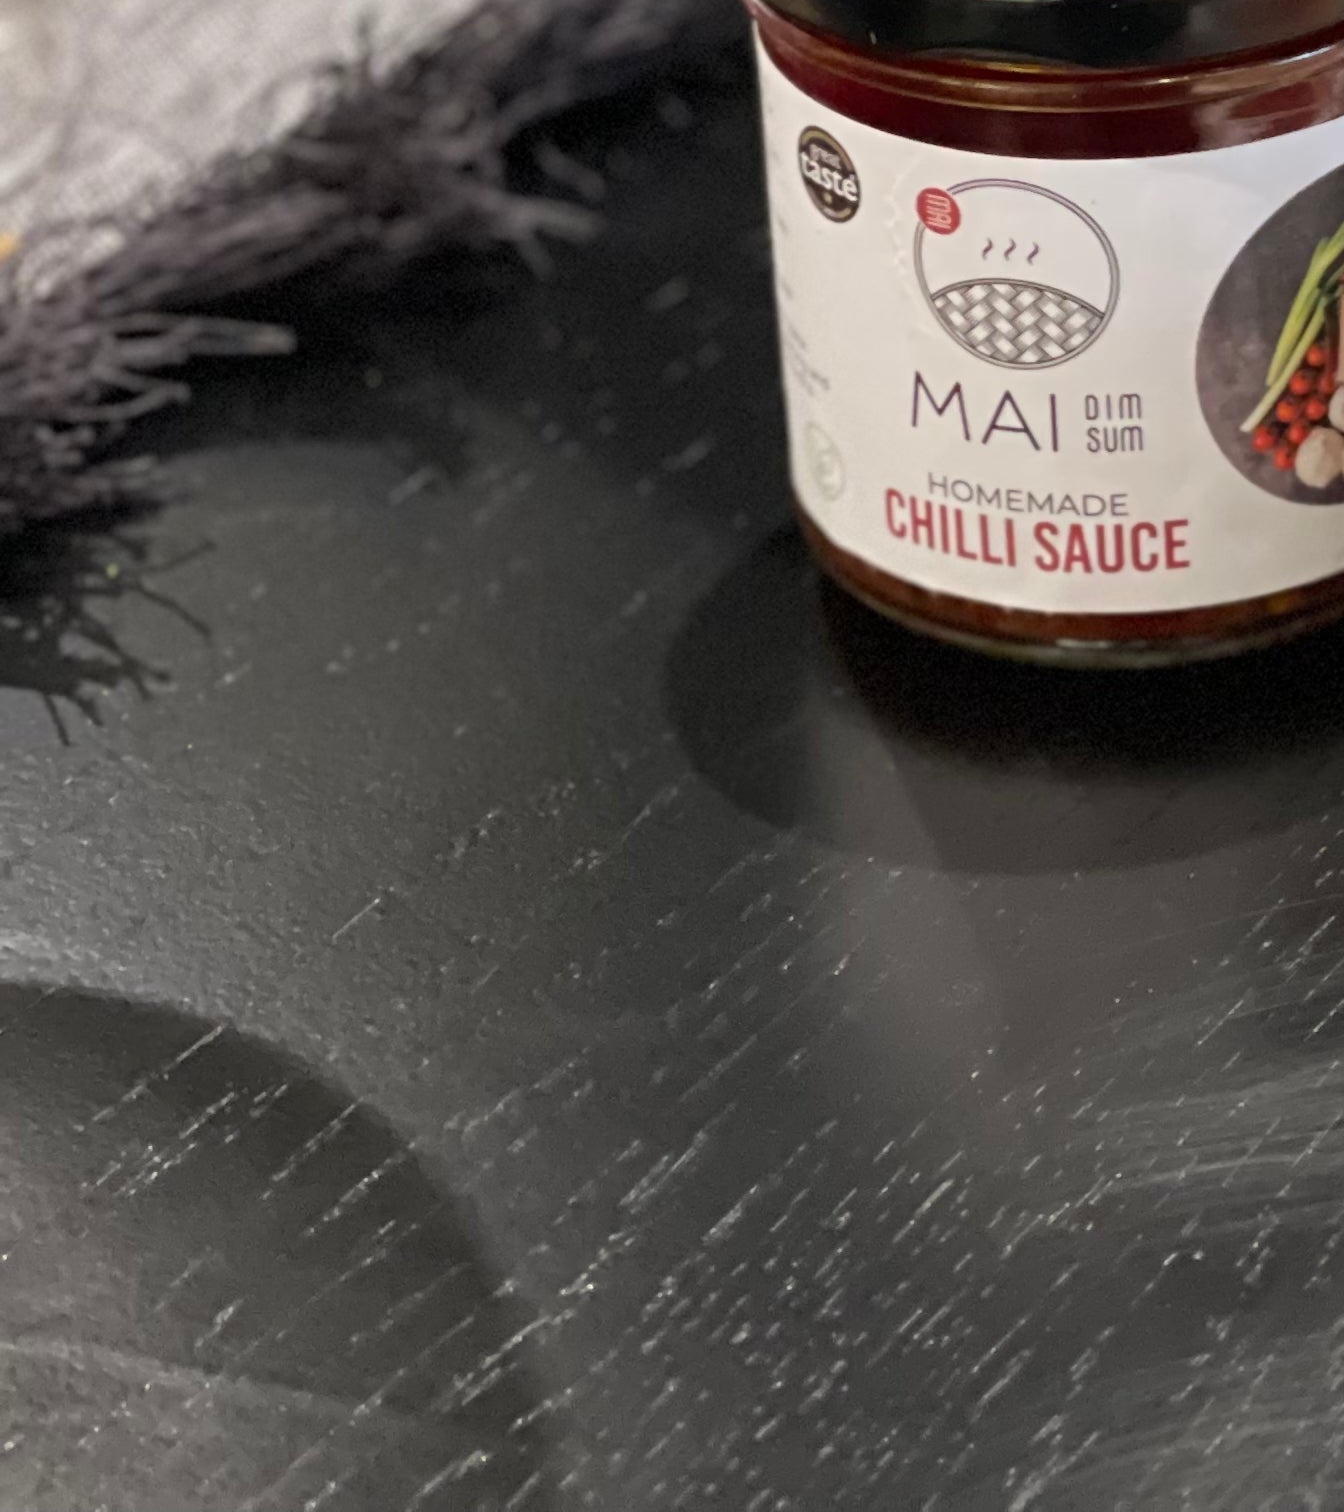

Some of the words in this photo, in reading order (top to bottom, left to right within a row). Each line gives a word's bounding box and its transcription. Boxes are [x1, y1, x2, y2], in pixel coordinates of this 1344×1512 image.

[911, 370, 1059, 453] MAI
[1084, 393, 1143, 421] DIM
[1086, 425, 1144, 454] SUM
[927, 472, 1130, 518] HOMEMADE
[884, 487, 1017, 568] CHILLI
[1032, 518, 1191, 574] SAUCE
